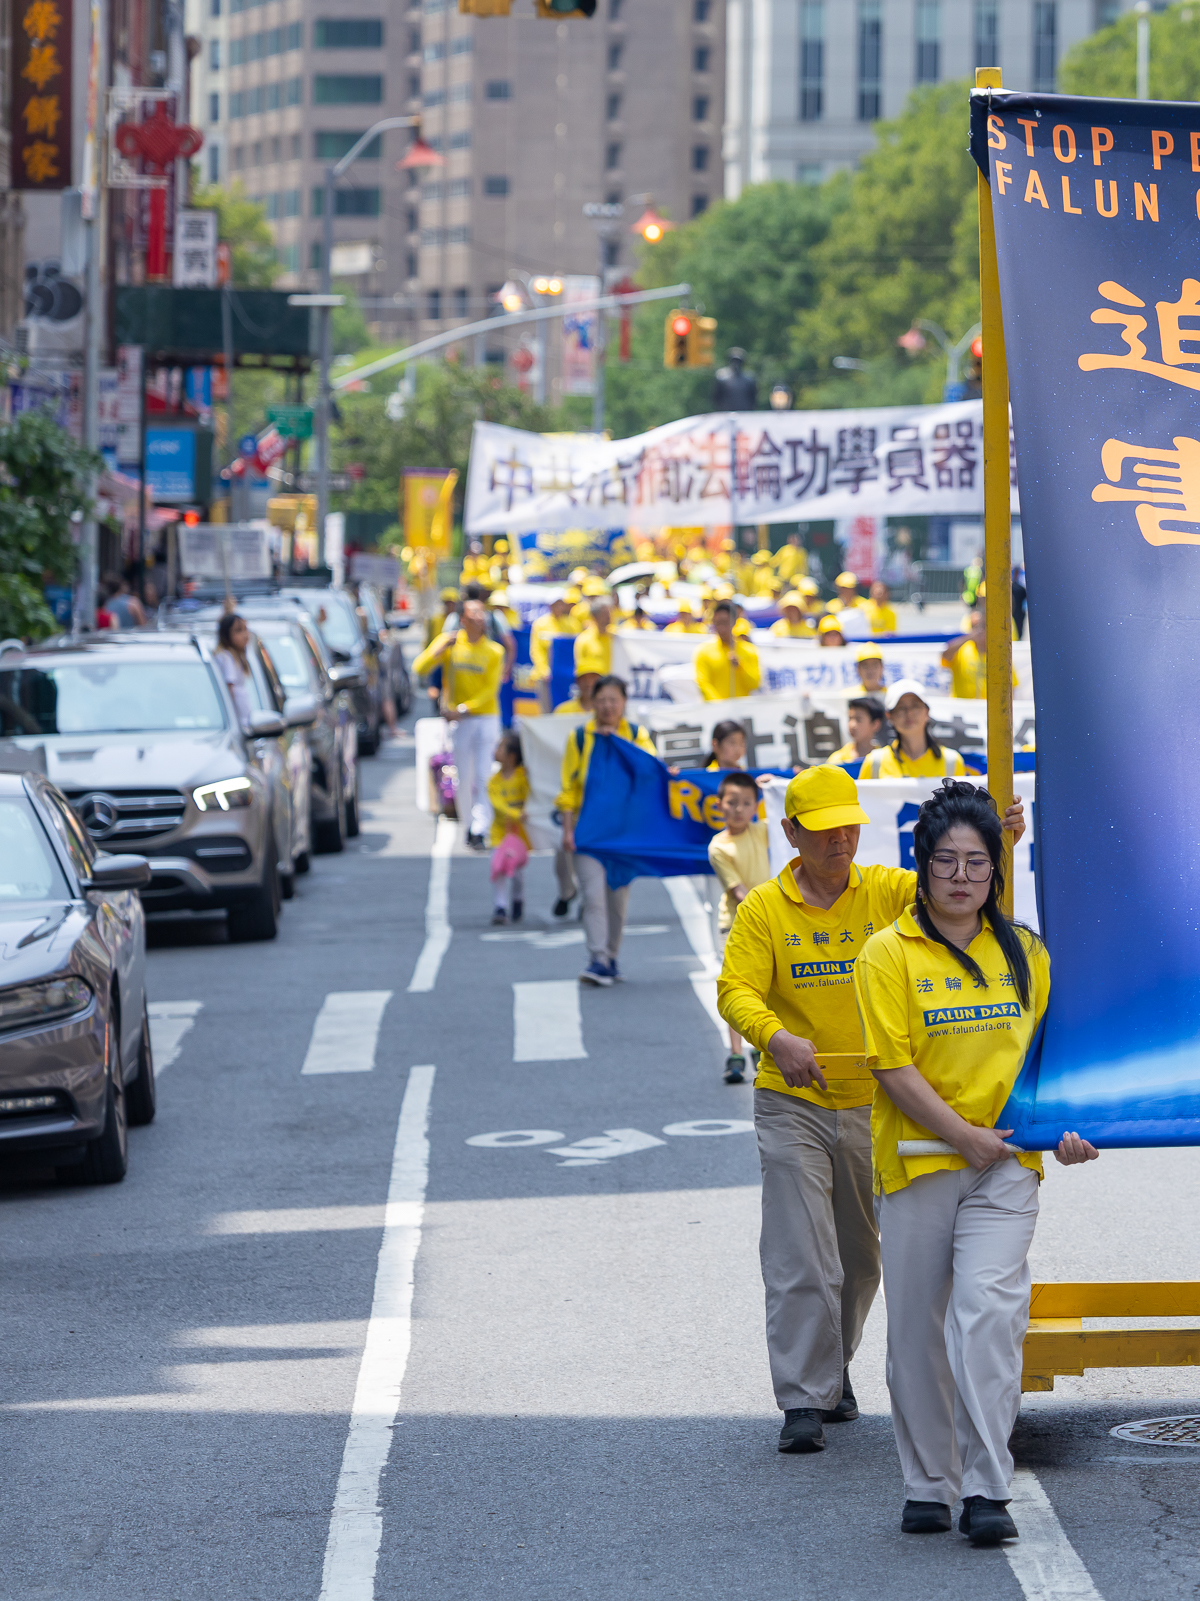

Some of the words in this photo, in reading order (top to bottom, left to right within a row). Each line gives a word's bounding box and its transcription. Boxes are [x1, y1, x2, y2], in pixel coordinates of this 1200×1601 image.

[987, 114, 1114, 166] STOP
[995, 160, 1159, 222] FALUN
[785, 921, 874, 947] 法輪大法
[795, 963, 841, 977] FALUN
[794, 975, 854, 990] www.falundaf
[928, 1008, 976, 1024] FALUN
[980, 1004, 1018, 1018] DAFA
[926, 1021, 1012, 1039] www.falundafa.org
